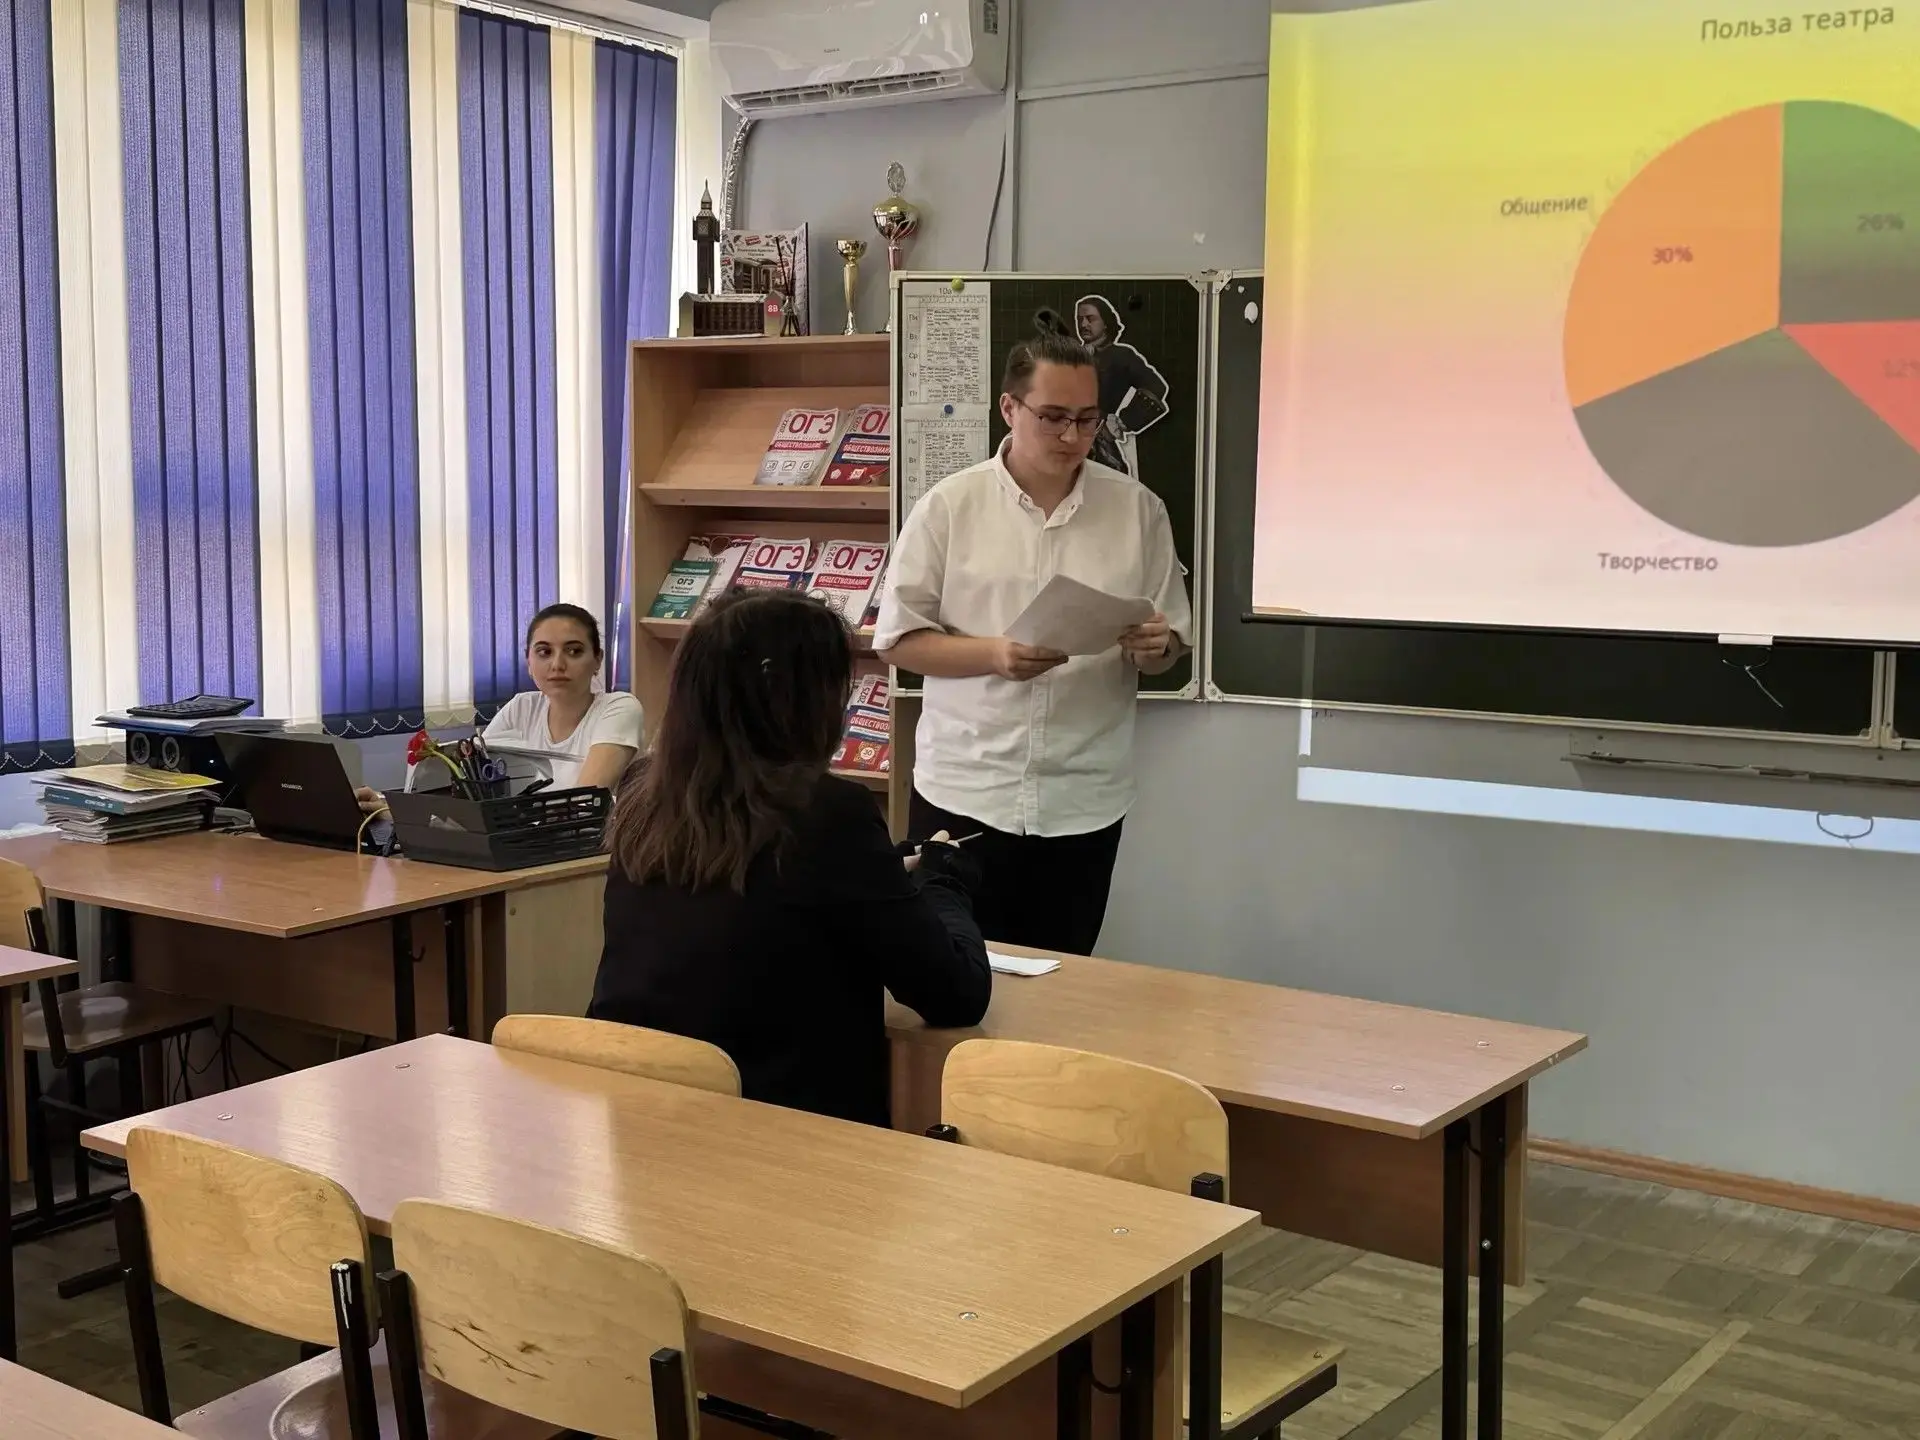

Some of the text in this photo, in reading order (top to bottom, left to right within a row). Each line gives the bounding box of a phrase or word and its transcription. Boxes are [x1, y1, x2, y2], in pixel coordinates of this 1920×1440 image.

[1701, 7, 1894, 41] Польза театра
[1500, 196, 1588, 218] Общение
[1652, 246, 1694, 265] 30%
[788, 413, 835, 434] ОГЭ
[755, 544, 805, 569] ОГЭ
[823, 546, 837, 567] 2025
[833, 546, 885, 571] ОГЭ
[1597, 552, 1718, 574] Творчество
